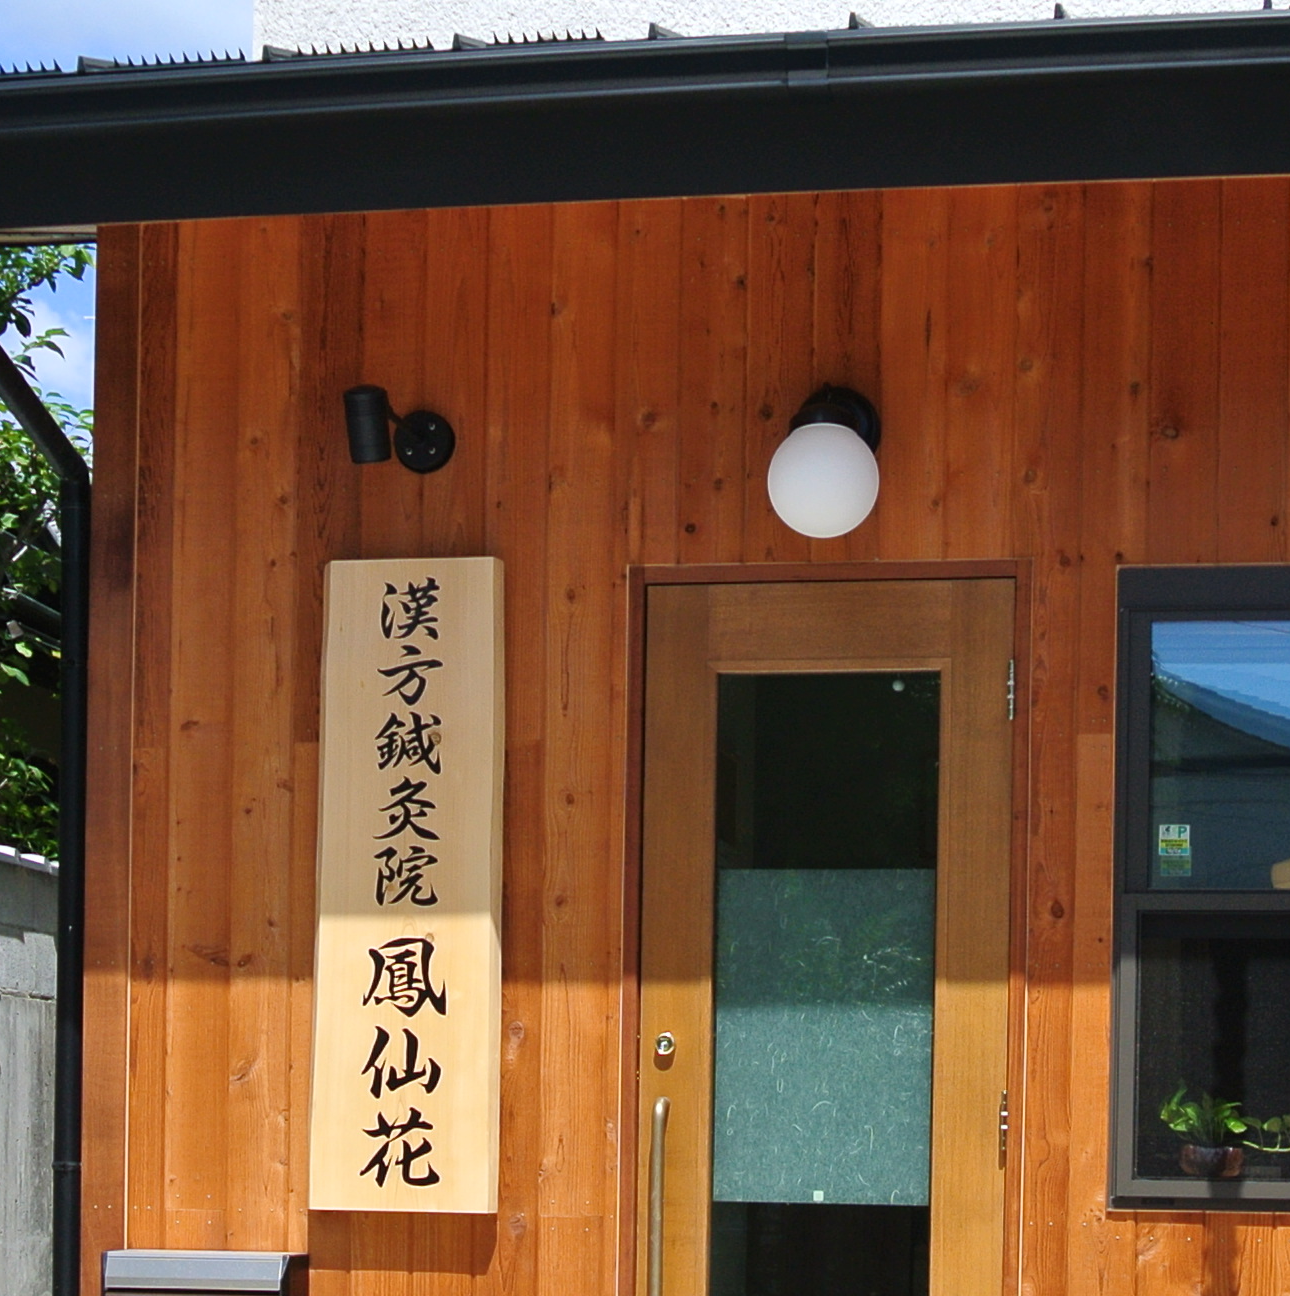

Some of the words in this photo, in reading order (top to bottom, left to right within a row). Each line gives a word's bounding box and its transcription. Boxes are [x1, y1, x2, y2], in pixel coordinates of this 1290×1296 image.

[373, 576, 444, 907] 漢方鍼灸院
[359, 937, 448, 1188] 鳳仙花
